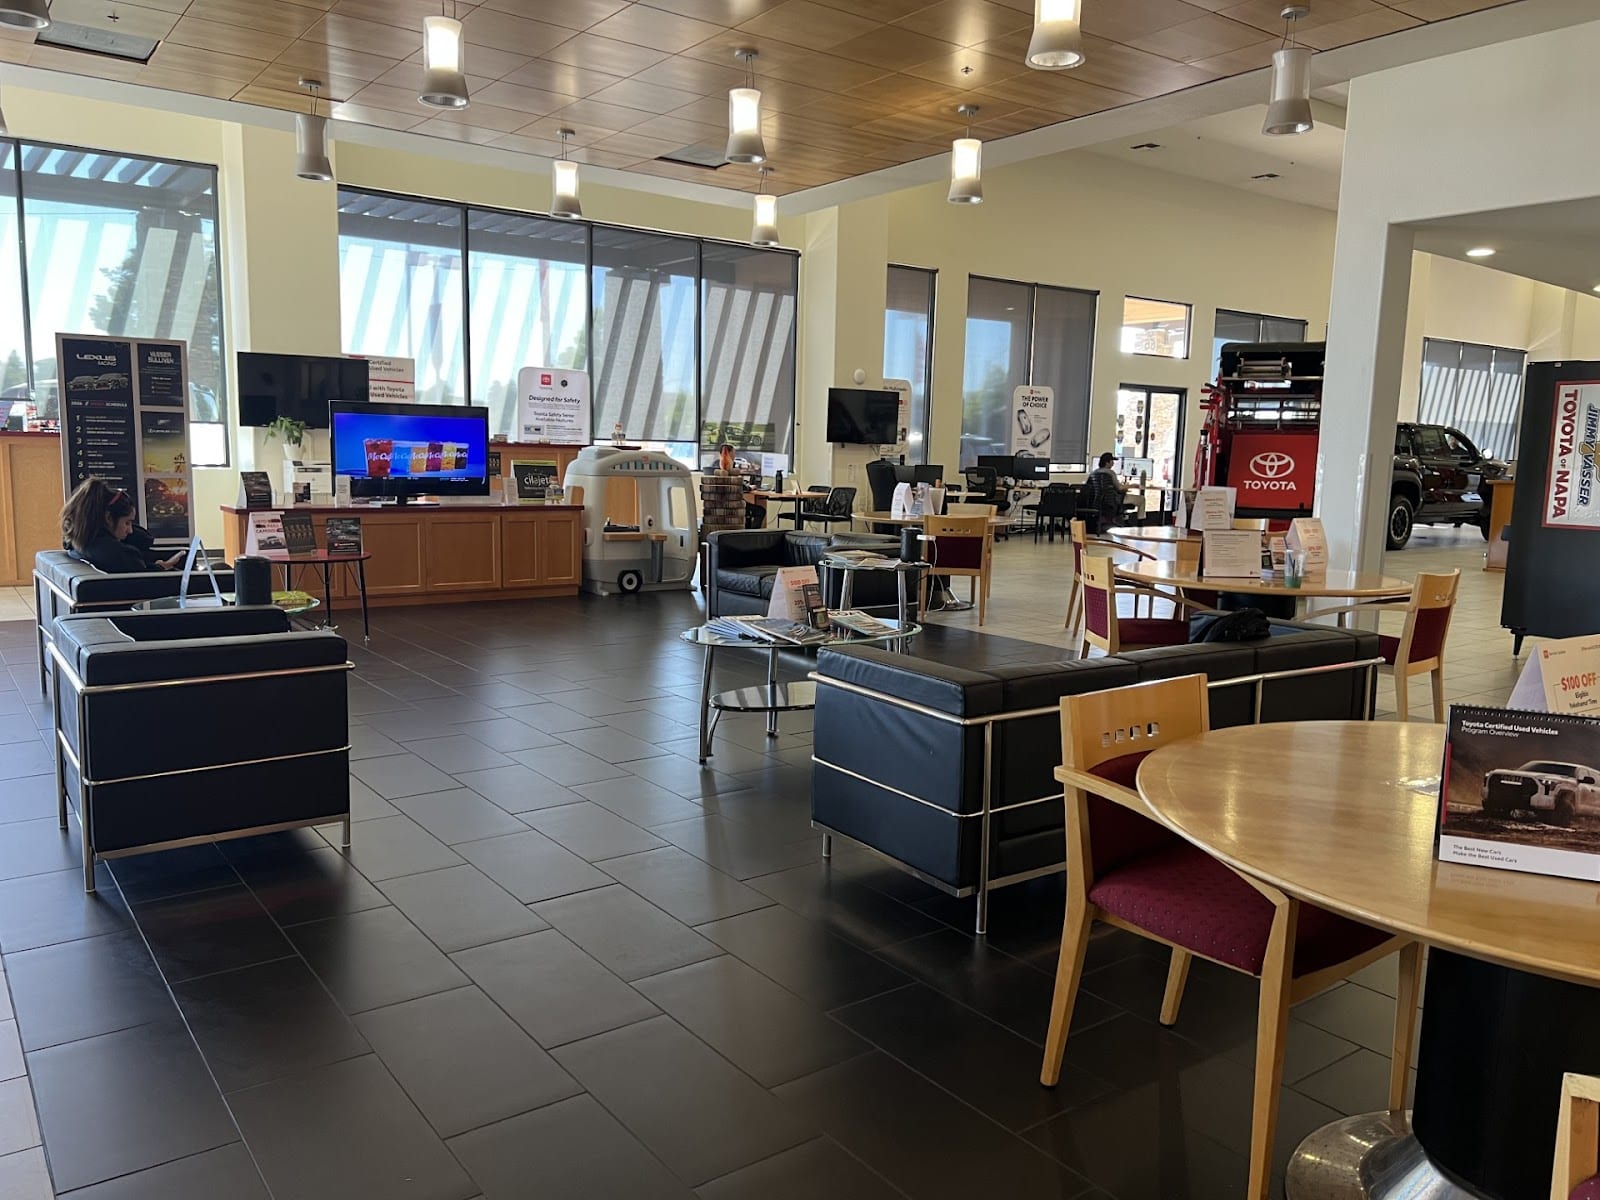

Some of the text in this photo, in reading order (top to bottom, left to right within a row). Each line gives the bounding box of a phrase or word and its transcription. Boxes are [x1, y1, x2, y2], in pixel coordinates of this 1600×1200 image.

[1559, 390, 1578, 457] TOYOTA
[1578, 403, 1598, 506] JIMMY VASSER
[1243, 480, 1297, 491] TOYOTA
[1552, 470, 1570, 518] NAPA
[1561, 672, 1596, 691] $100 OFF
[1461, 726, 1519, 737] Program Overview
[1462, 720, 1484, 728] Toyota
[1484, 722, 1513, 731] Certified
[1531, 727, 1559, 735] Vehicles
